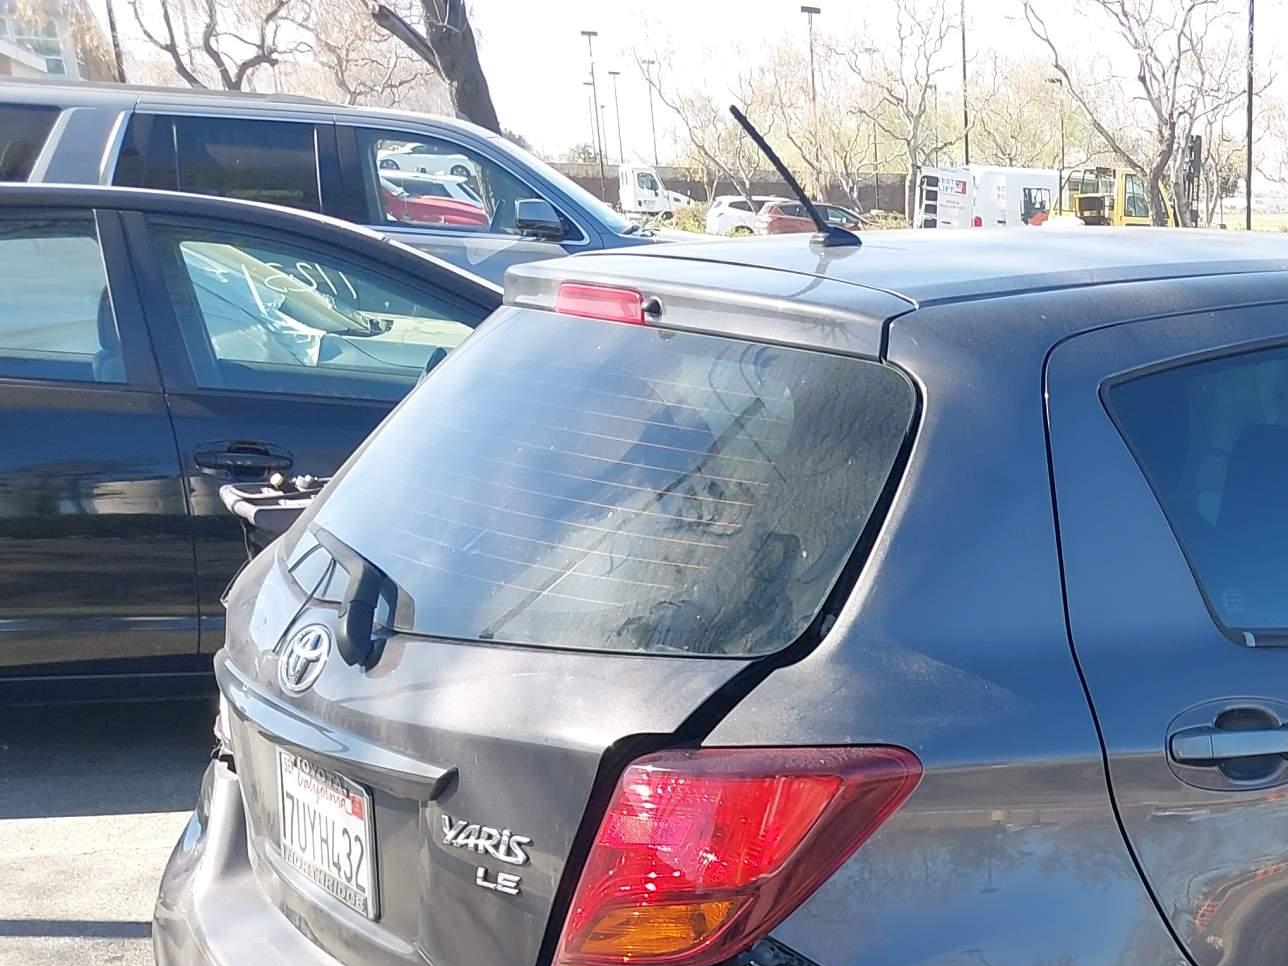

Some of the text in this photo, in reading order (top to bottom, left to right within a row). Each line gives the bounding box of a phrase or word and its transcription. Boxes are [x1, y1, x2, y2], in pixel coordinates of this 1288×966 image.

[294, 755, 346, 792] TOYOTA
[286, 793, 366, 894] 7UYH432
[476, 867, 522, 895] LE
